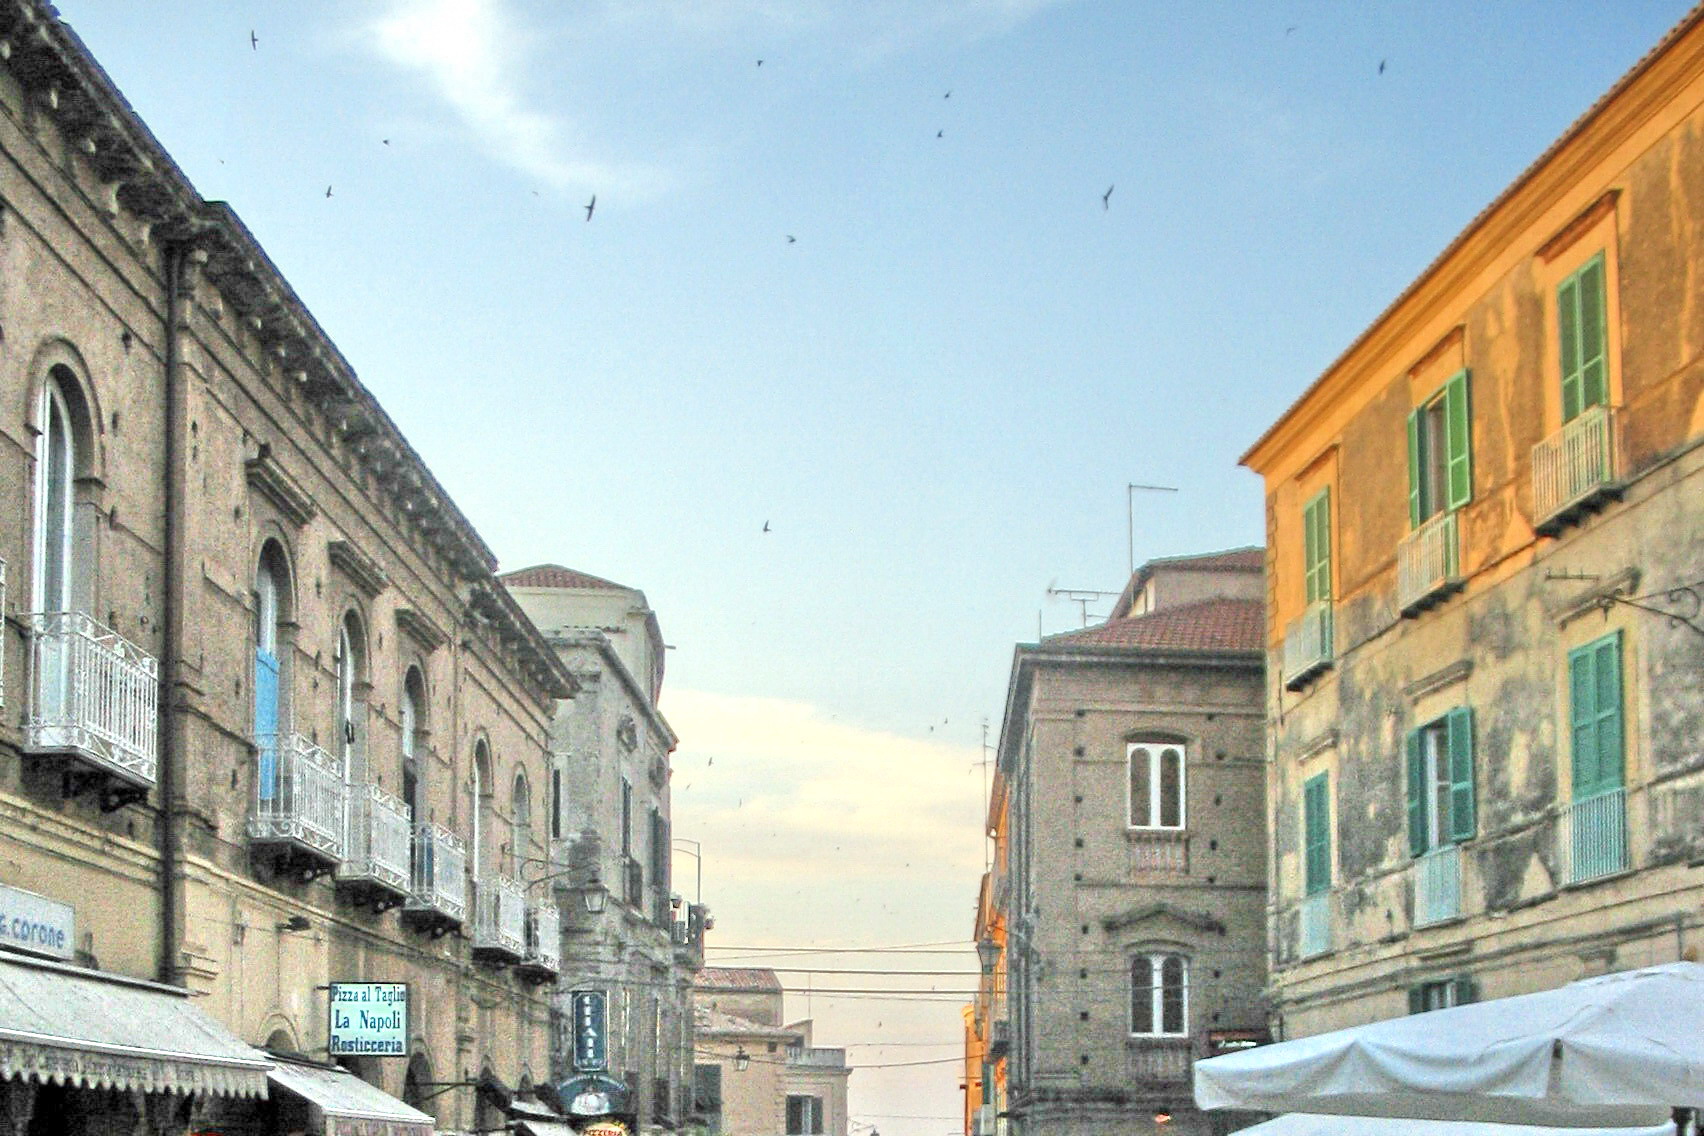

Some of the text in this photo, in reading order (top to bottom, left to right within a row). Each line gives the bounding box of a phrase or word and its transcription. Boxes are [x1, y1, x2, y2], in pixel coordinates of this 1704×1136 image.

[331, 985, 406, 1006] Pizza al Taglio
[335, 1009, 401, 1033] La Napoli
[332, 1034, 404, 1053] Rosticceria
[583, 1129, 623, 1136] PIZZERIA
